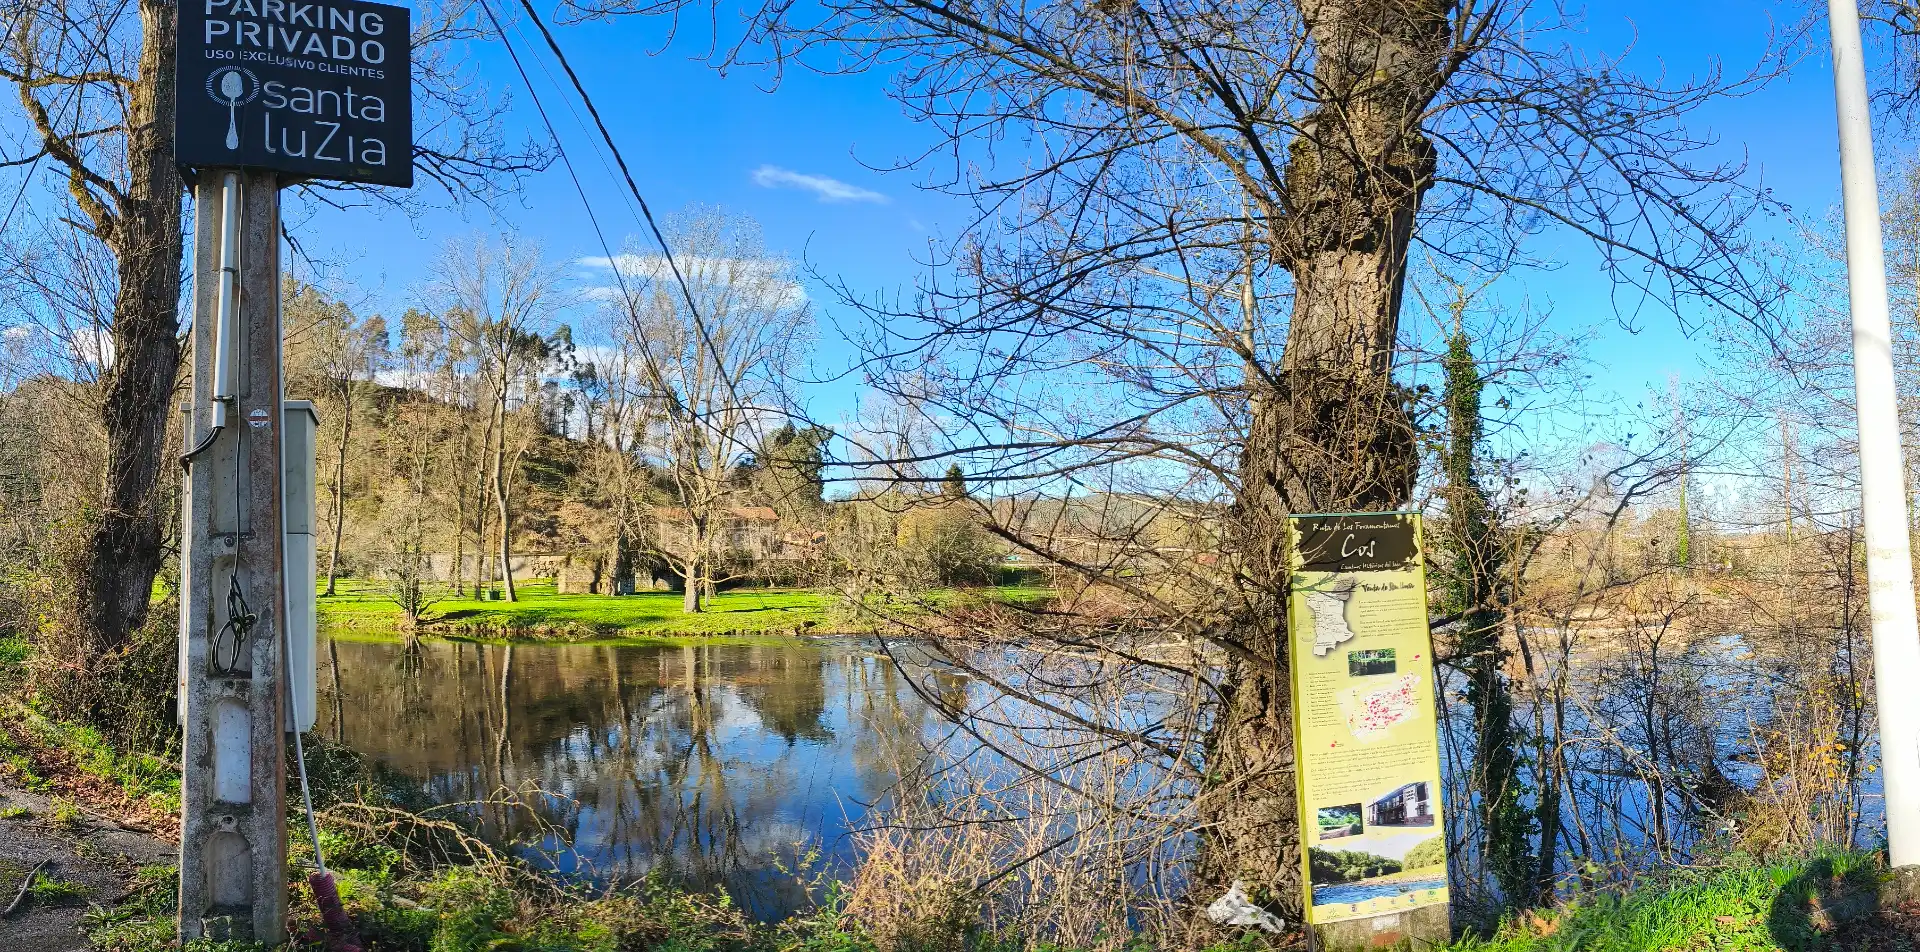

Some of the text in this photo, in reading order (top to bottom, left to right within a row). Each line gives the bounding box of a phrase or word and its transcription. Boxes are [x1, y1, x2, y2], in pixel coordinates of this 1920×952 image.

[205, 0, 384, 35] PARKING
[205, 19, 385, 64] PRIVADO
[205, 49, 385, 80] USO EXCLUSIVO CLIENTES
[262, 80, 385, 123] santa
[1312, 523, 1333, 532] Ruta
[1342, 522, 1354, 531] Los
[1341, 533, 1376, 558] Cos
